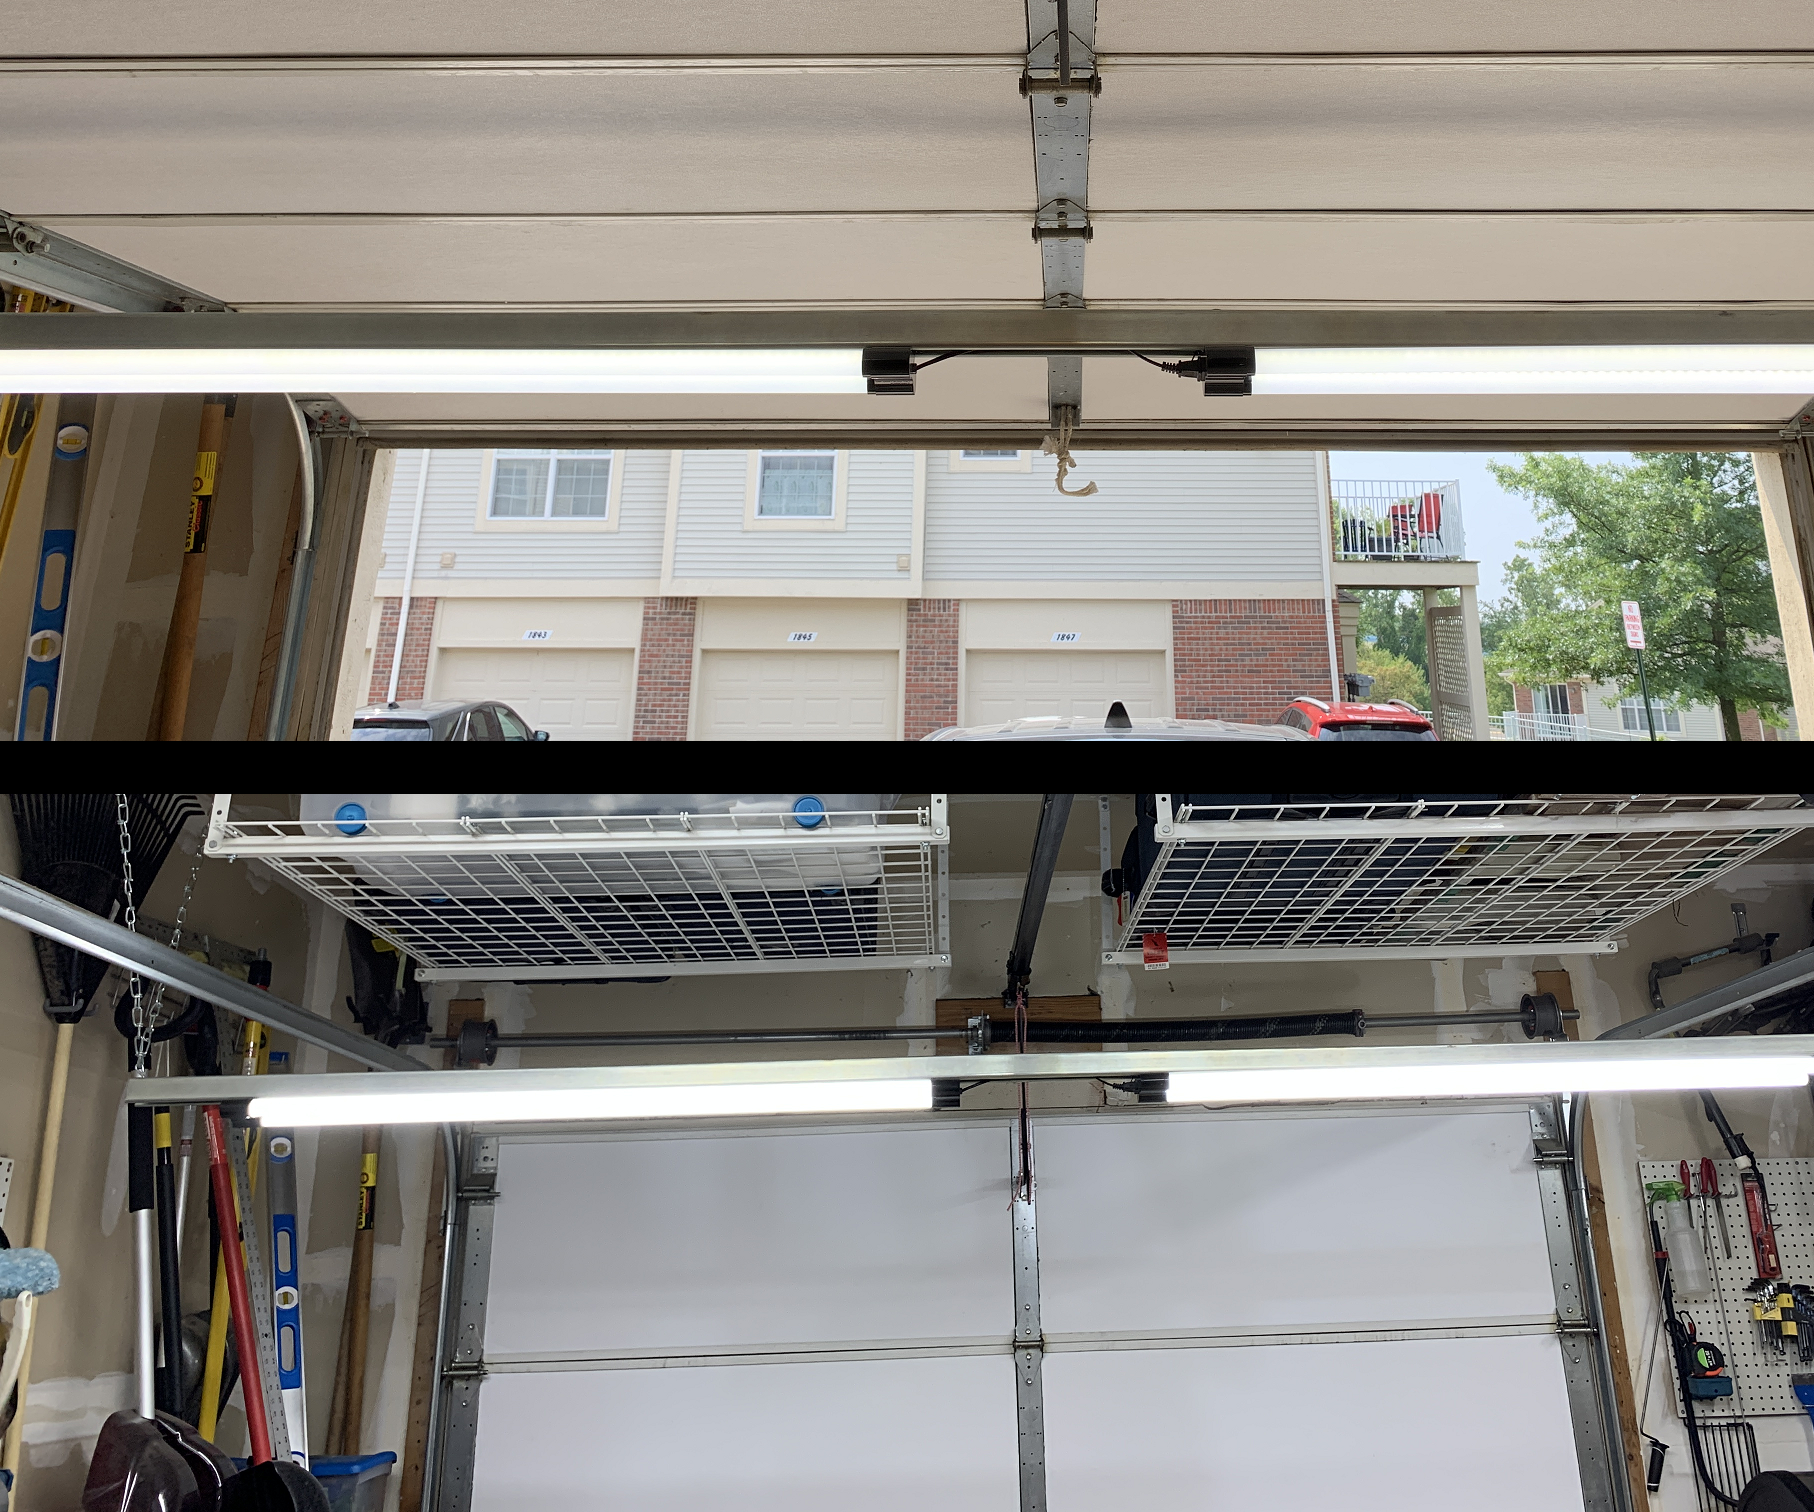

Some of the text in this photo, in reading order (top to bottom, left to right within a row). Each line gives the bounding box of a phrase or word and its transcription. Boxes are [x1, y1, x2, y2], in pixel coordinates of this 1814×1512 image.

[193, 500, 203, 532] Classic
[185, 501, 195, 548] STANLEY
[528, 631, 547, 639] 1843
[793, 633, 813, 641] 1845
[1056, 633, 1076, 641] 1847
